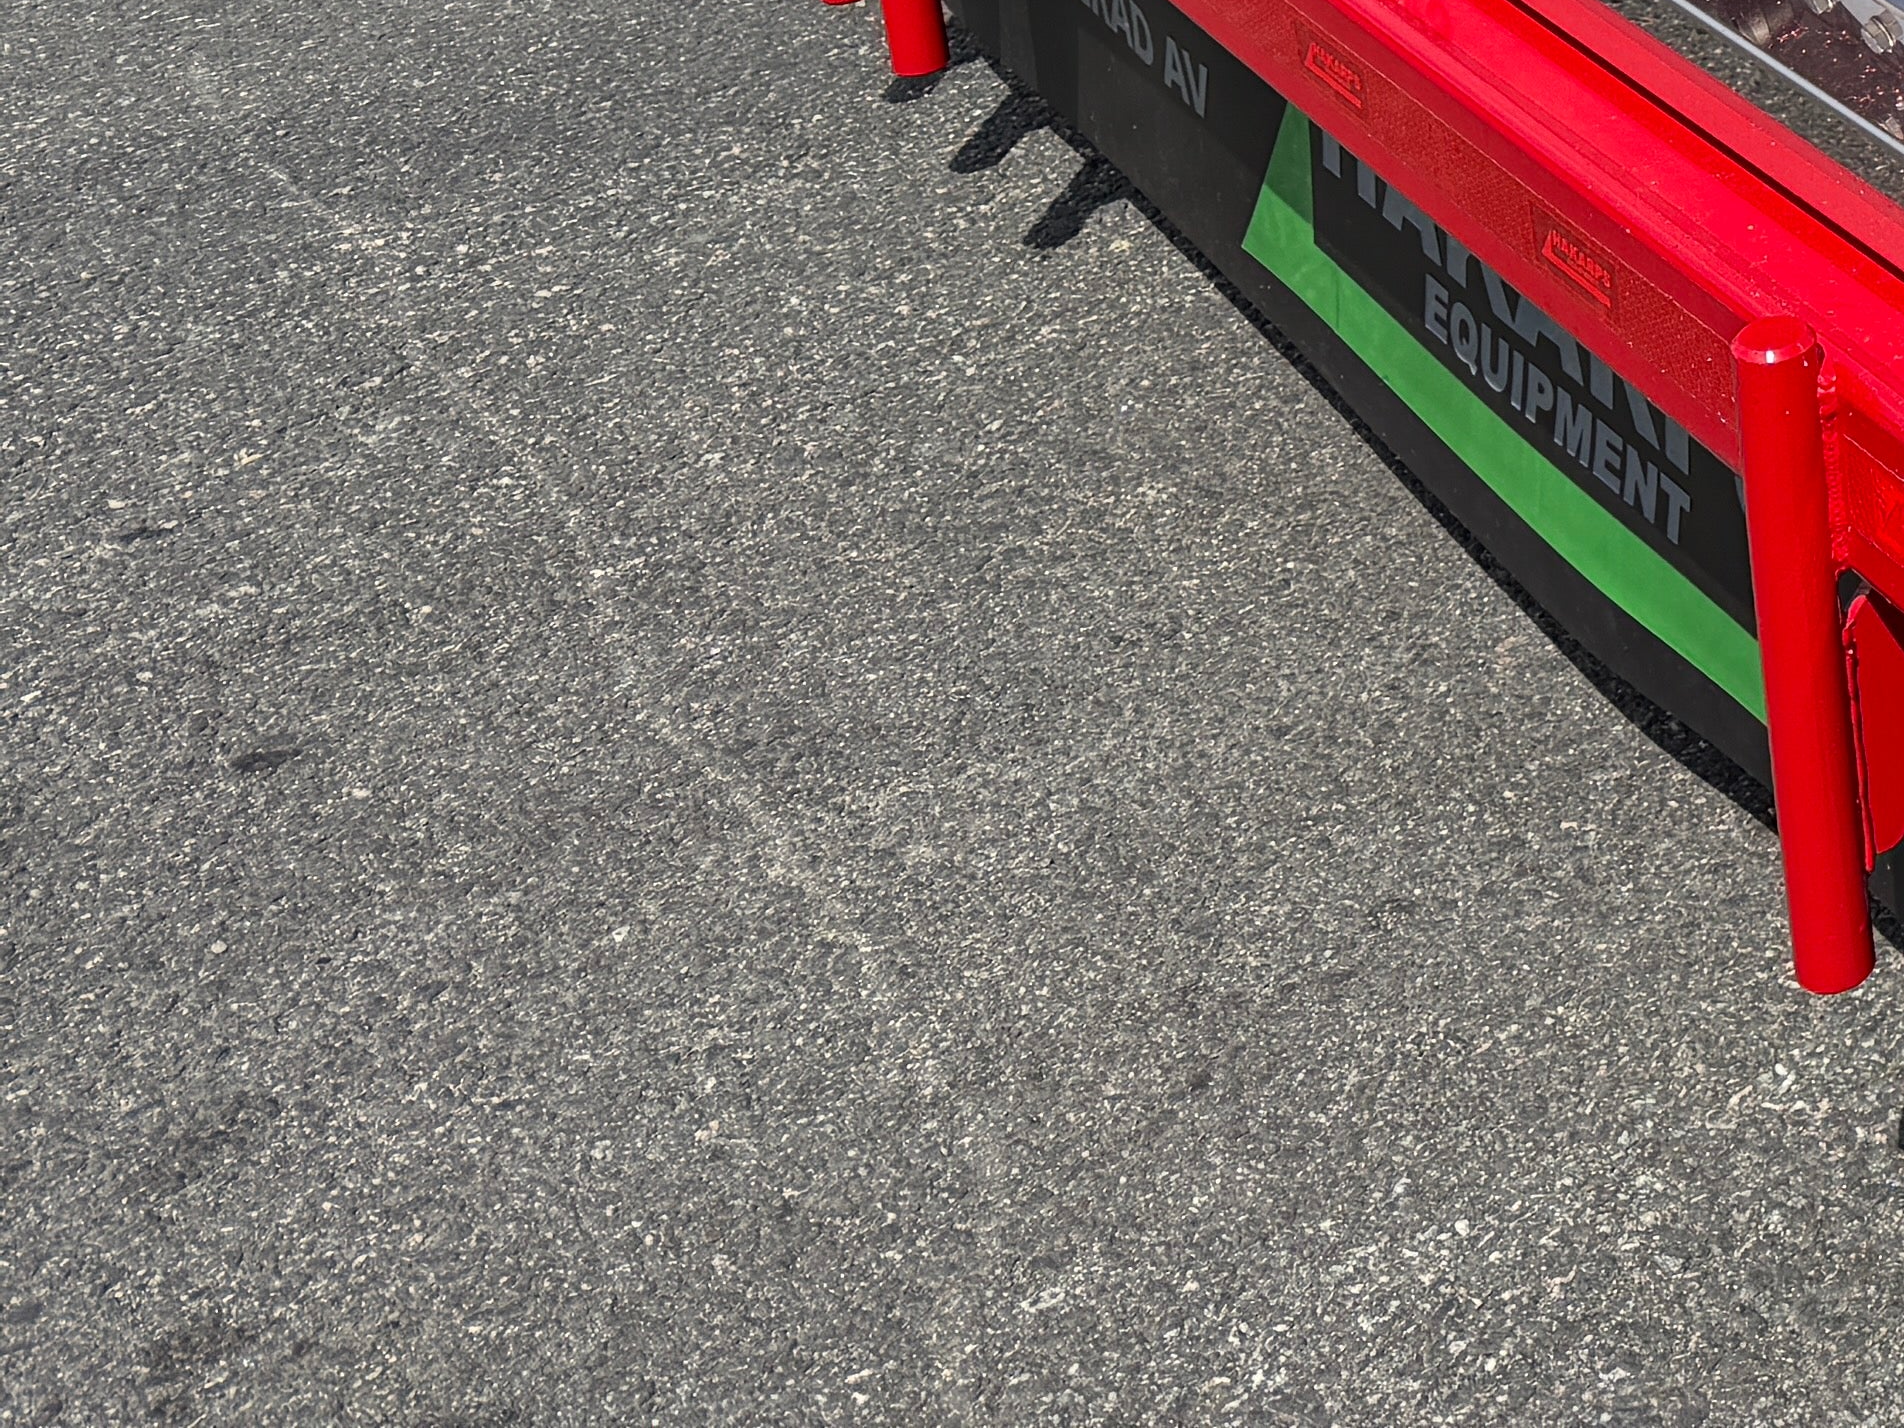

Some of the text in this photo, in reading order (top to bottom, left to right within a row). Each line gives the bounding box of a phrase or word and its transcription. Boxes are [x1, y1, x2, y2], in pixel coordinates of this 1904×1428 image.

[1163, 35, 1208, 119] AV
[1549, 228, 1613, 289] HAKARPS
[1424, 272, 1692, 545] EQUIPMENT
